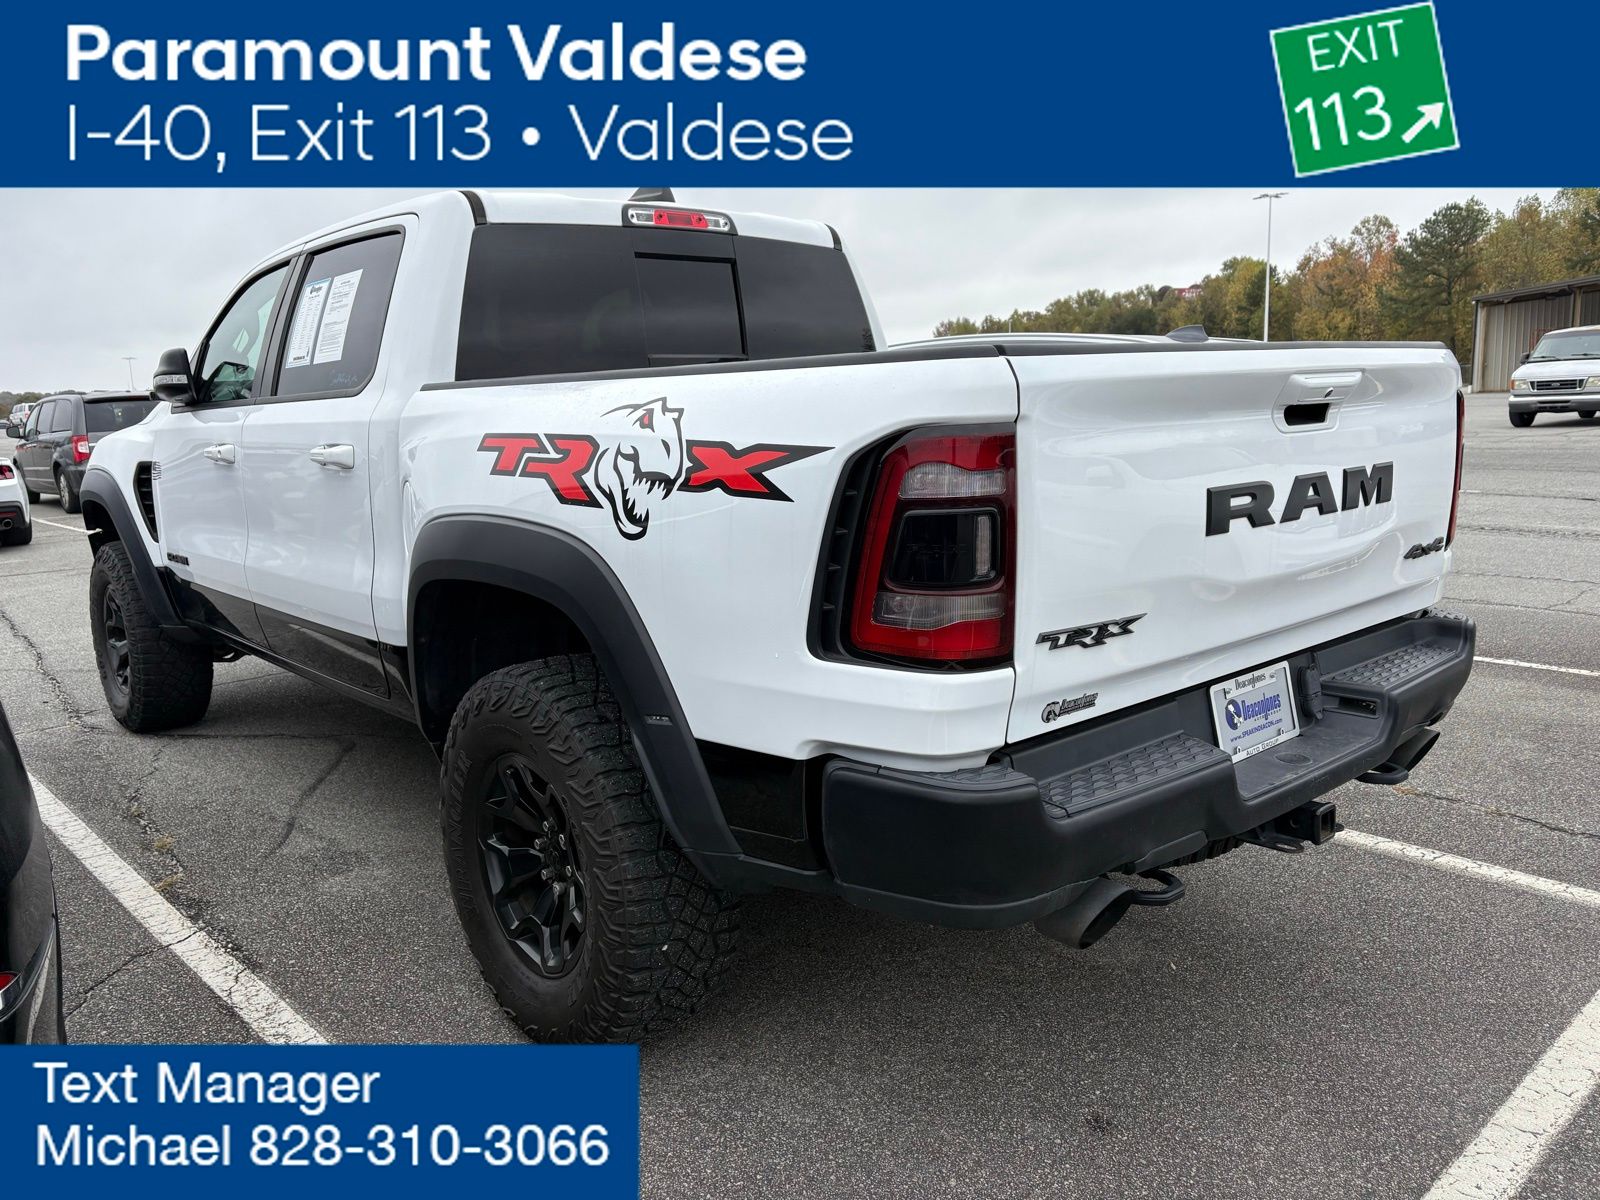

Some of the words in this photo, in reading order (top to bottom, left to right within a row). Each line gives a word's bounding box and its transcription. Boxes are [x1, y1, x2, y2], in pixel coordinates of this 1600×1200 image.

[1205, 461, 1394, 537] RAM
[1035, 612, 1148, 651] TRX
[1246, 745, 1261, 756] AUTO
[1261, 738, 1279, 750] GROUP
